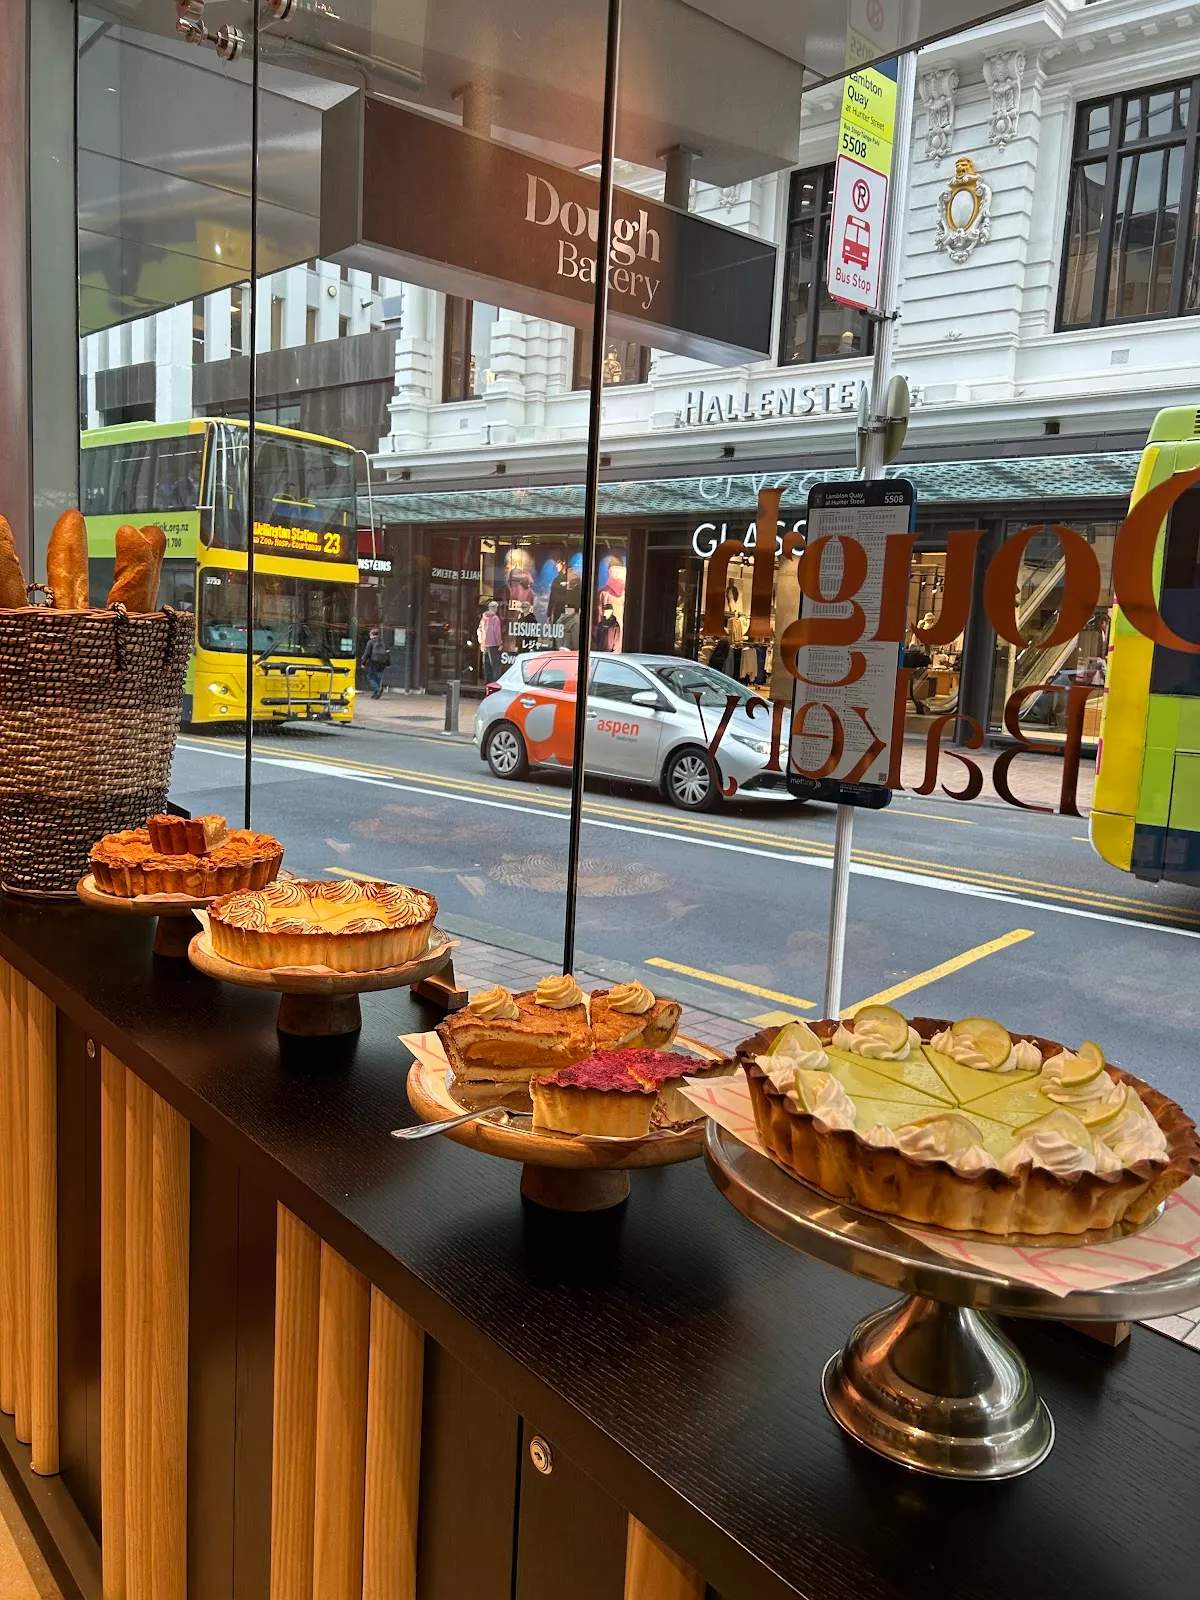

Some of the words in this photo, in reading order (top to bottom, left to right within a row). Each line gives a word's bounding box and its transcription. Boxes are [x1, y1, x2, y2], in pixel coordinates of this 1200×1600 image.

[847, 85, 869, 110] Quay
[849, 72, 883, 98] Lambton
[852, 106, 870, 122] Hunter
[870, 115, 885, 132] Street
[842, 133, 867, 159] 5508
[835, 267, 850, 284] Bus
[852, 273, 871, 294] Stop
[884, 495, 904, 504] 5508
[323, 532, 341, 554] 23
[508, 622, 542, 637] LEISURE
[542, 623, 565, 638] CLUB
[597, 719, 640, 737] aspen
